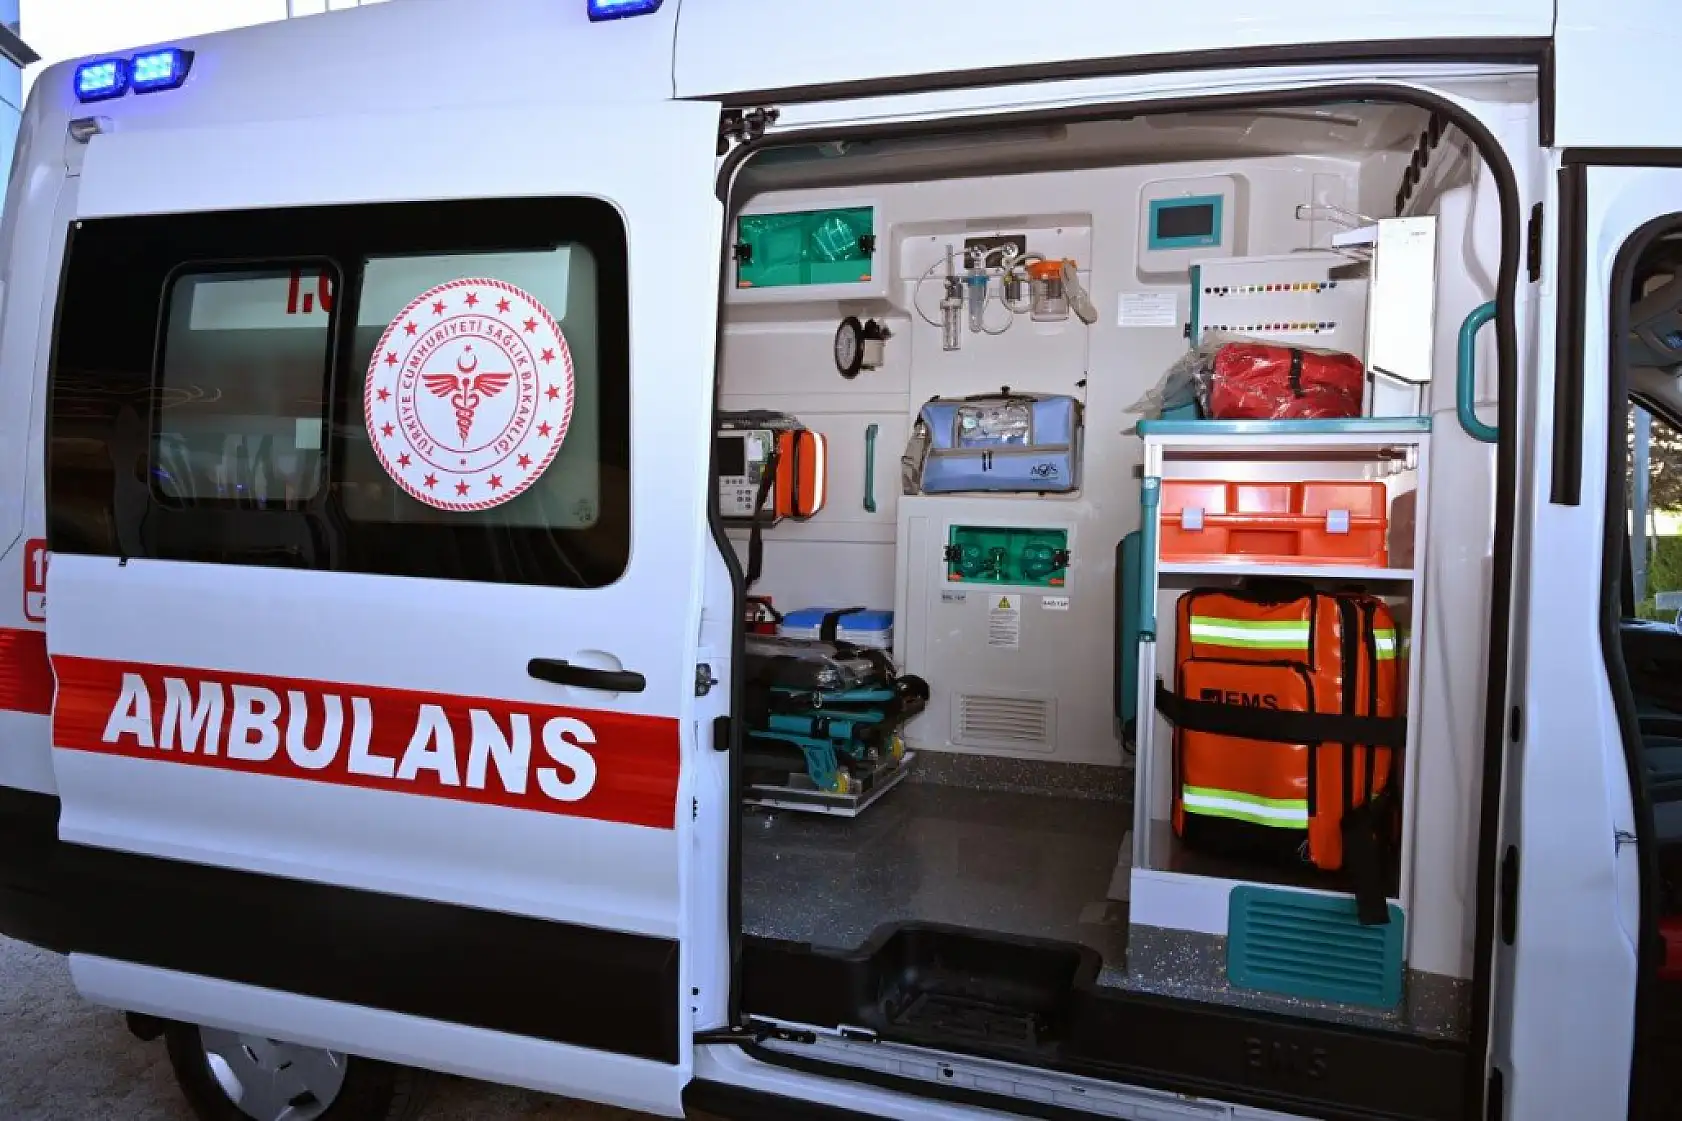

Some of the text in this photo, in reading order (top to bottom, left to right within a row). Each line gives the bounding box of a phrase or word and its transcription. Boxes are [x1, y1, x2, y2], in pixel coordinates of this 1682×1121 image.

[402, 319, 533, 457] TÜRKİYE CUMHURİYETİ SAĞLIK BAKANLIĞI
[102, 671, 598, 802] AMBULANS
